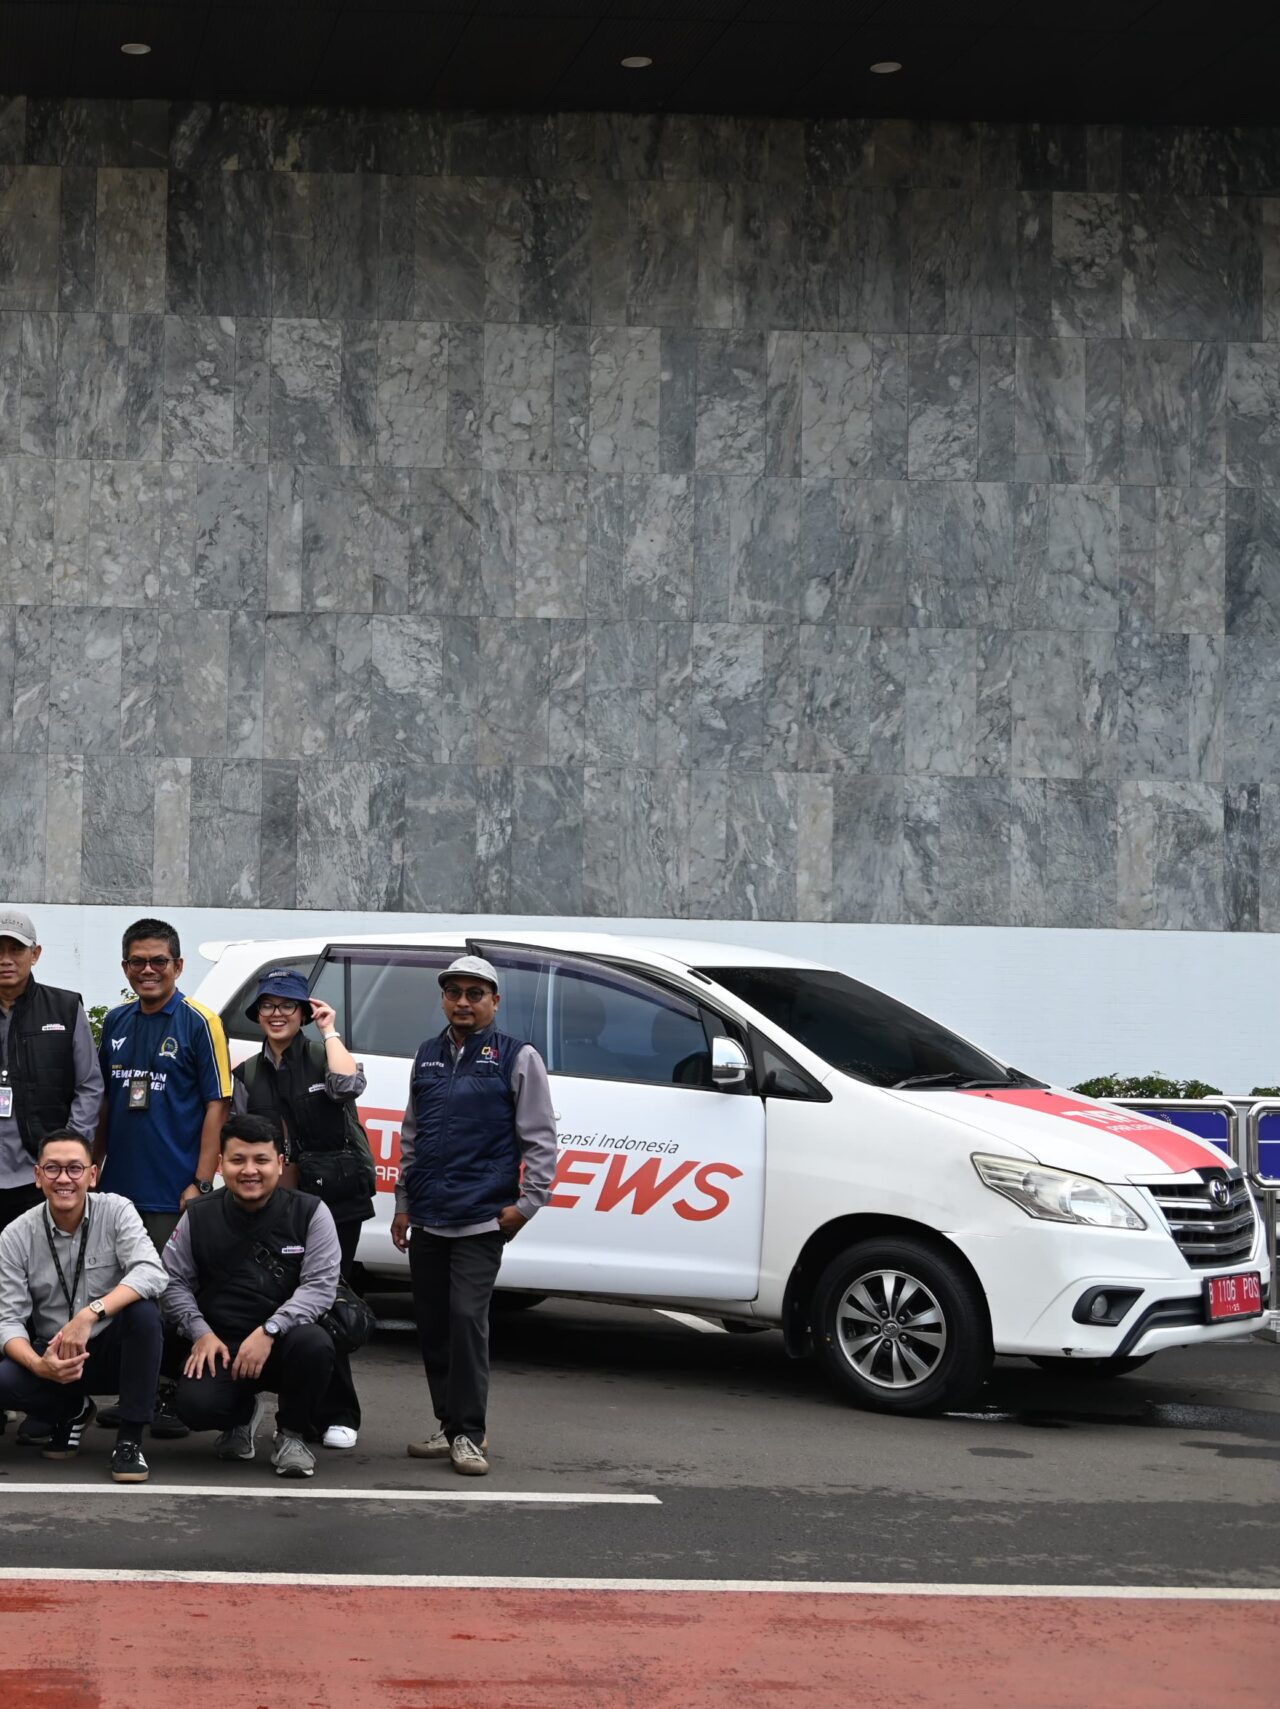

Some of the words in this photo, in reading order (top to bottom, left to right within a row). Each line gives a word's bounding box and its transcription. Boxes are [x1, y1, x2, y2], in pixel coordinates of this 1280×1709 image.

[557, 1133, 598, 1147] rensi
[598, 1134, 680, 1154] Indonesia
[521, 1149, 744, 1222] EWS
[1218, 1279, 1236, 1302] 1106
